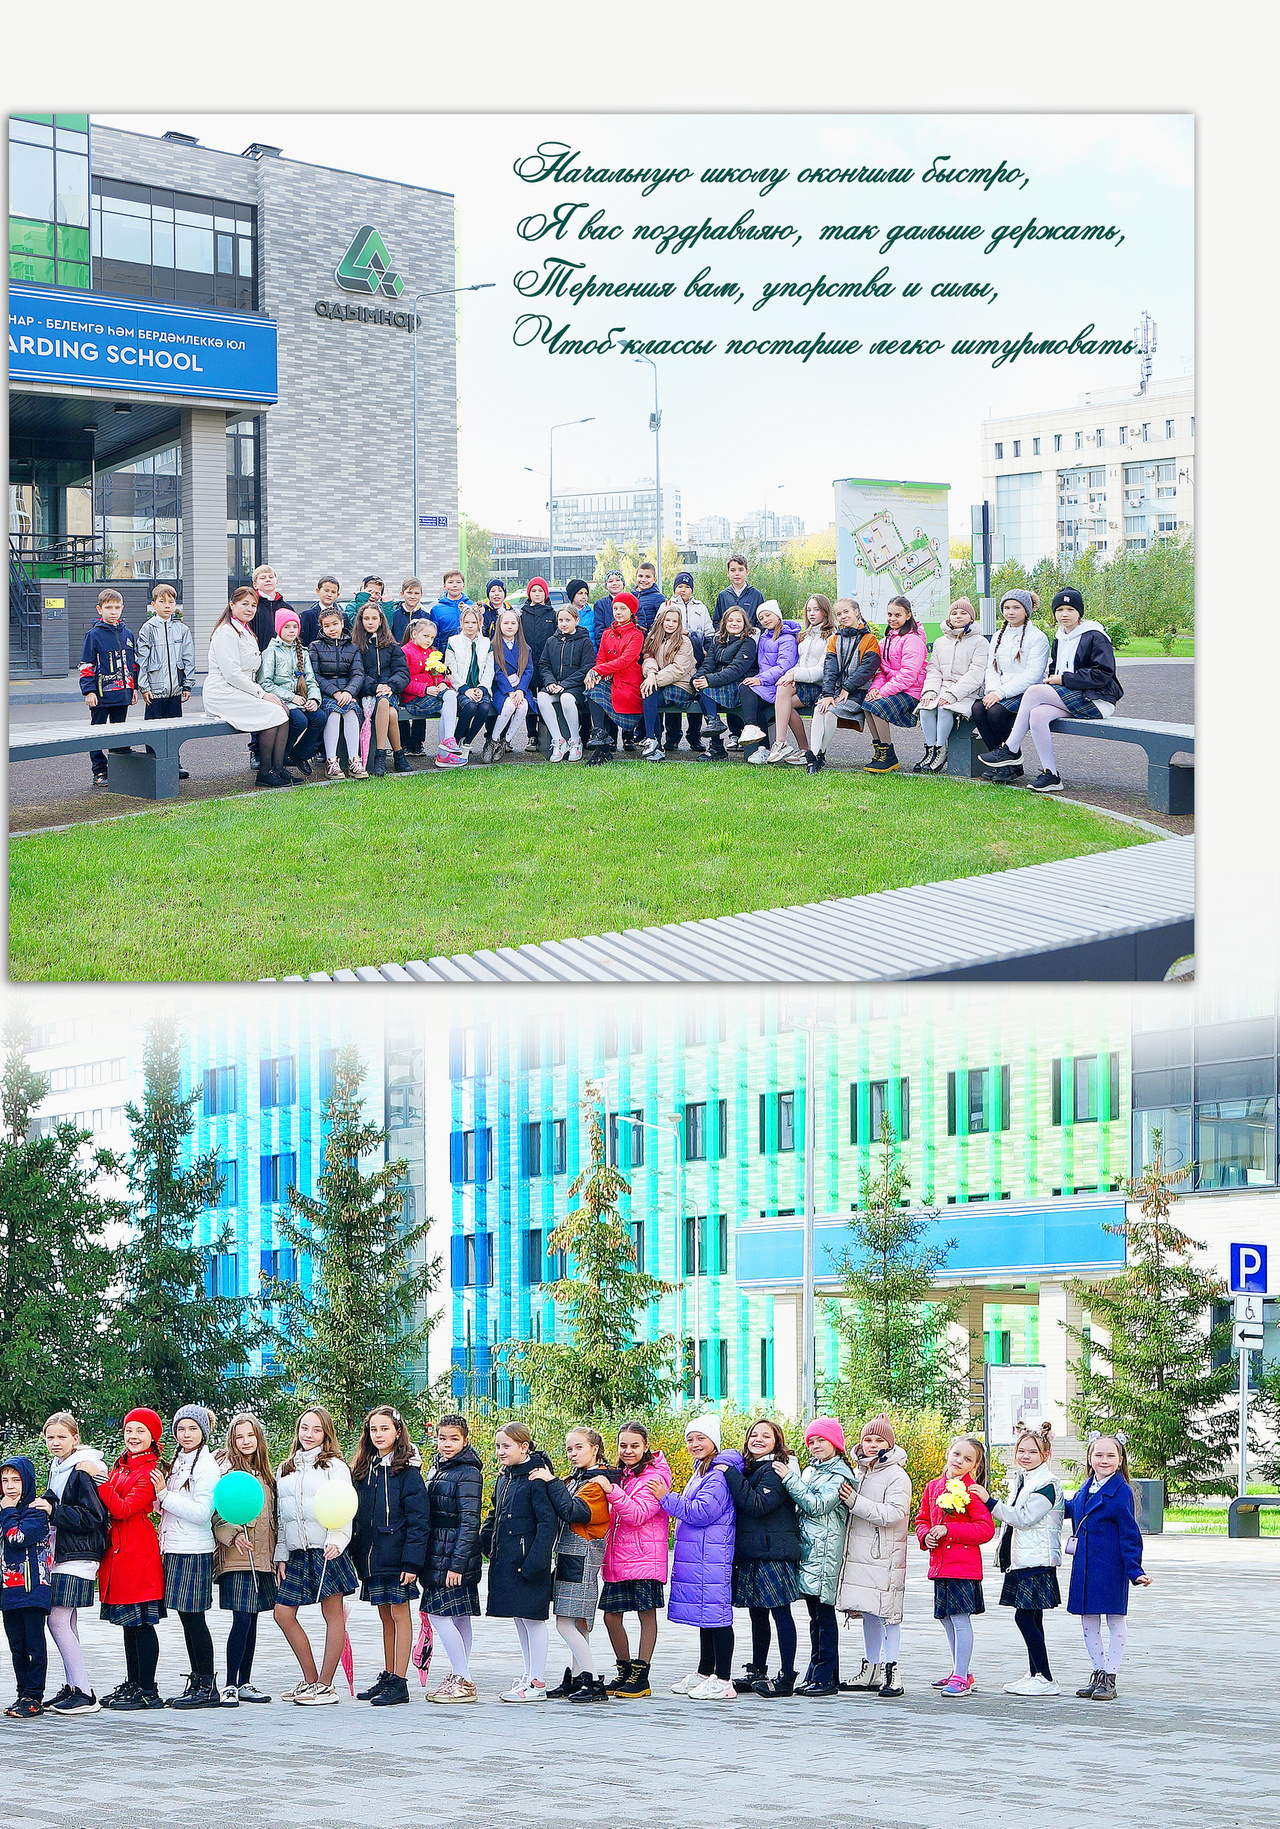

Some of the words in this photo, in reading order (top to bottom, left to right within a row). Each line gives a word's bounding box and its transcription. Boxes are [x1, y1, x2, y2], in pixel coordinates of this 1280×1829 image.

[9, 314, 35, 326] НАР
[46, 318, 104, 335] БЕЛЕМГӘ
[138, 329, 224, 348] БЕРДӘМЛЕККӘ
[226, 339, 246, 351] ЮЛ
[314, 299, 422, 333] адымнар
[106, 345, 203, 372] SCHOOL
[1239, 1247, 1262, 1289] P
